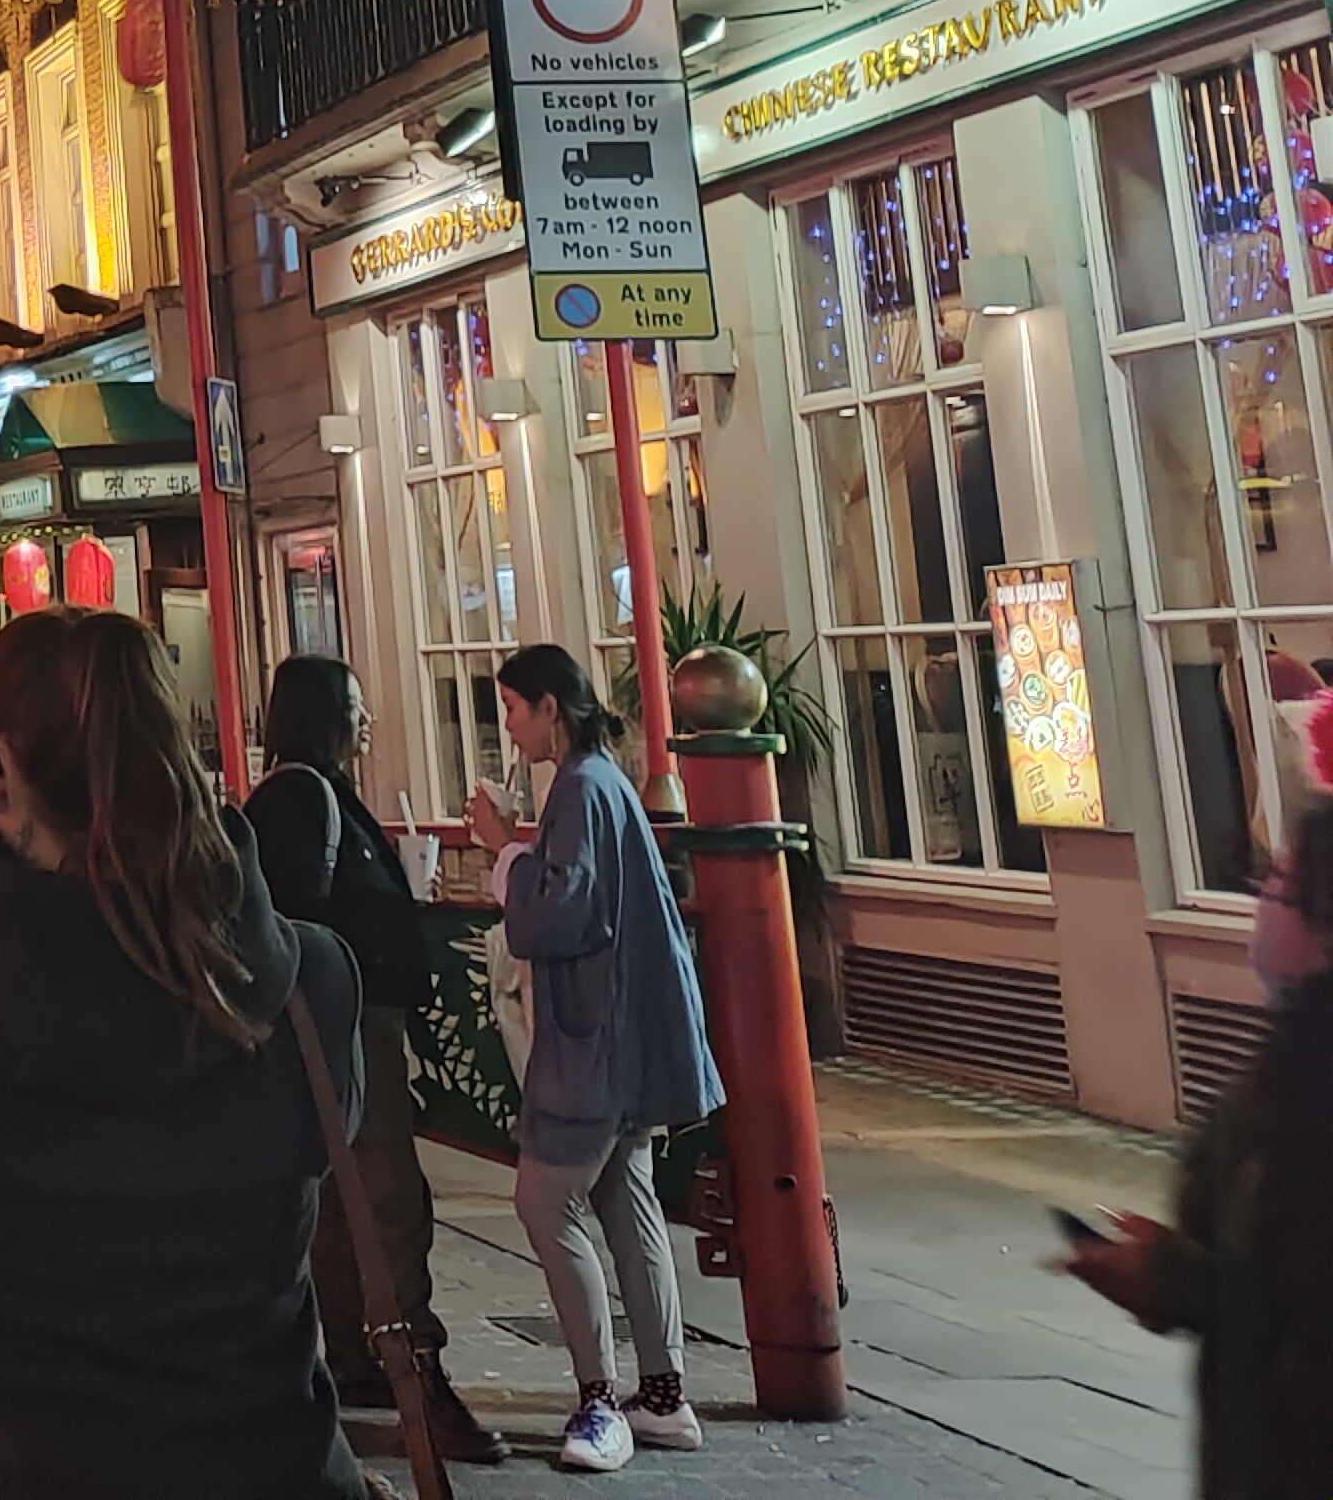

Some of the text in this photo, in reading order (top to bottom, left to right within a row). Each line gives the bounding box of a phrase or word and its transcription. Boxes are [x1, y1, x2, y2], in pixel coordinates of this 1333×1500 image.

[531, 52, 659, 72] No vehicles
[542, 91, 656, 112] Except for
[721, 60, 851, 143] CHINESE
[544, 114, 658, 135] loading by
[563, 193, 660, 211] between
[535, 217, 586, 235] 7am
[606, 217, 630, 234] 12
[638, 219, 693, 234] noon
[350, 204, 478, 285] GERRARD'S
[562, 241, 610, 260] Mon
[629, 240, 673, 259] Sun
[620, 283, 692, 305] At any
[634, 308, 684, 327] time
[1038, 580, 1068, 602] DAILY
